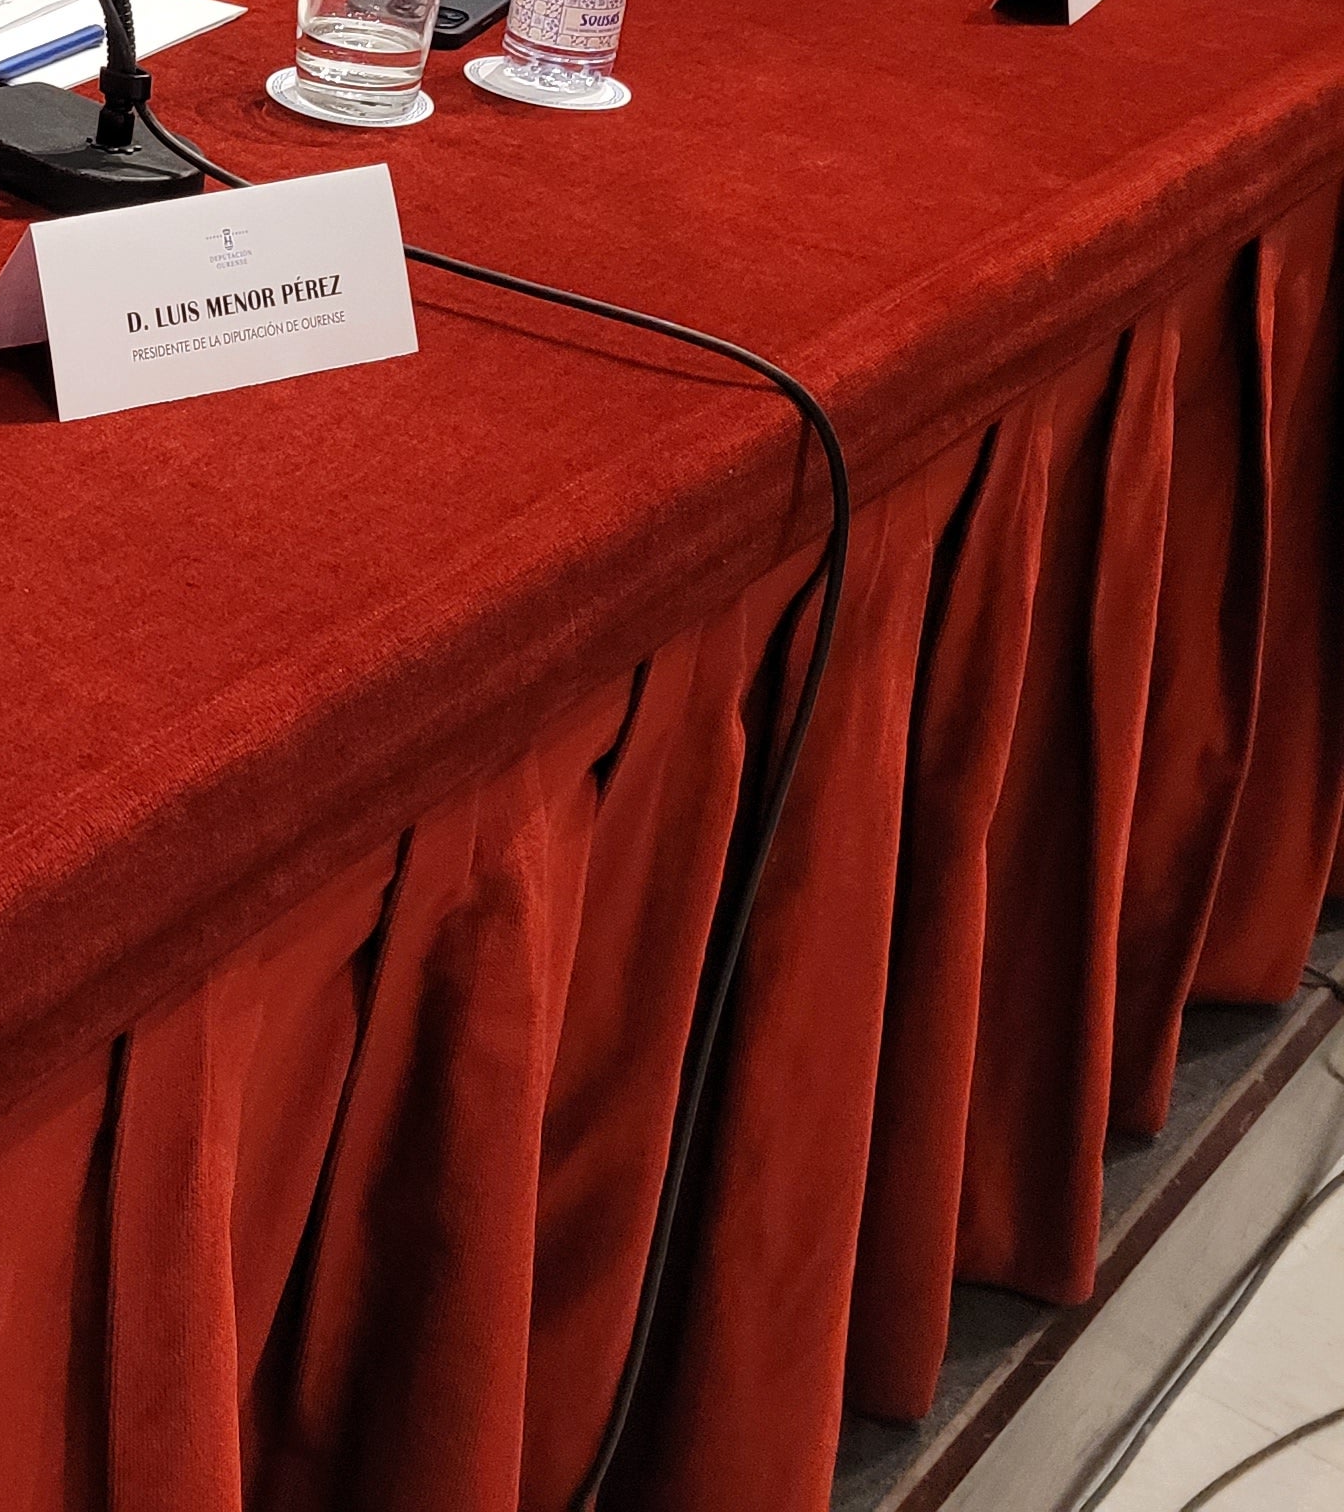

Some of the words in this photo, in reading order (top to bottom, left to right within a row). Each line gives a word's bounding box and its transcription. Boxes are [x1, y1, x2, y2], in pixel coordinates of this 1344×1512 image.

[127, 311, 149, 333] D.
[155, 300, 200, 328] LUIS
[206, 288, 276, 320] MENOR
[281, 274, 342, 305] PÉREZ
[132, 339, 191, 362] PRESIDENTE
[193, 336, 208, 351] DE
[209, 334, 221, 347] LA
[223, 321, 285, 345] DIPUTACIÓN
[286, 319, 300, 333] DE
[301, 310, 346, 330] OURENSE
